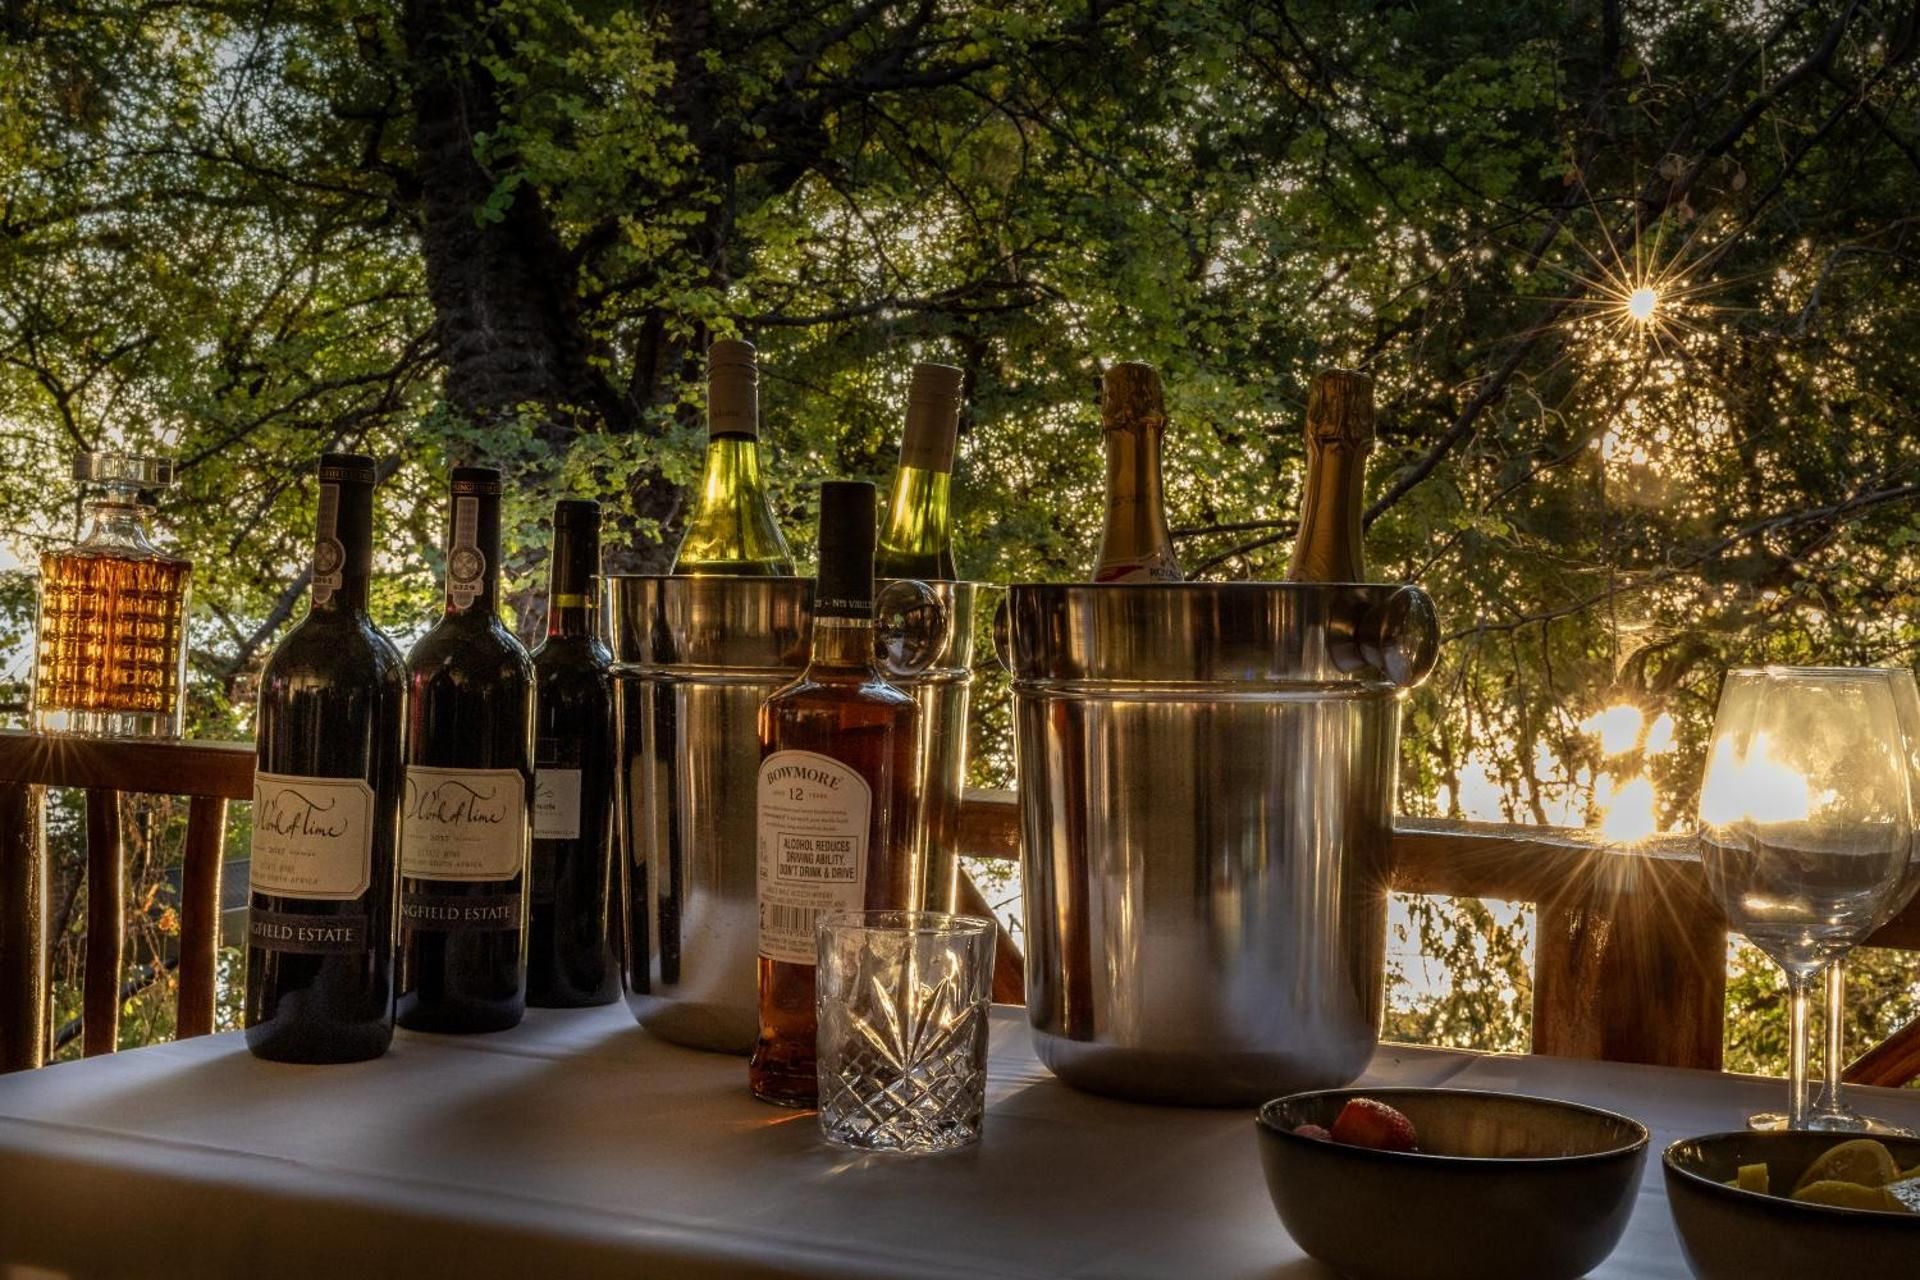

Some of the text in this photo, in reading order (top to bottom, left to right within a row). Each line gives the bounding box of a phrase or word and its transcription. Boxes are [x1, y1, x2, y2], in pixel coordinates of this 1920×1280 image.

[767, 766, 841, 791] BOWMORE
[437, 781, 506, 823] Time
[790, 788, 803, 801] 12
[276, 789, 347, 838] Time
[449, 802, 465, 826] of
[286, 812, 301, 840] of
[783, 838, 850, 852] ALCOHOL REDUCES
[786, 852, 814, 864] DRIVING
[779, 864, 798, 876] DON'T
[800, 866, 822, 877] DRINK
[823, 867, 830, 879] &
[832, 867, 855, 879] DRIVE
[465, 907, 511, 920] ESTATE
[299, 927, 354, 941] ESTATE
